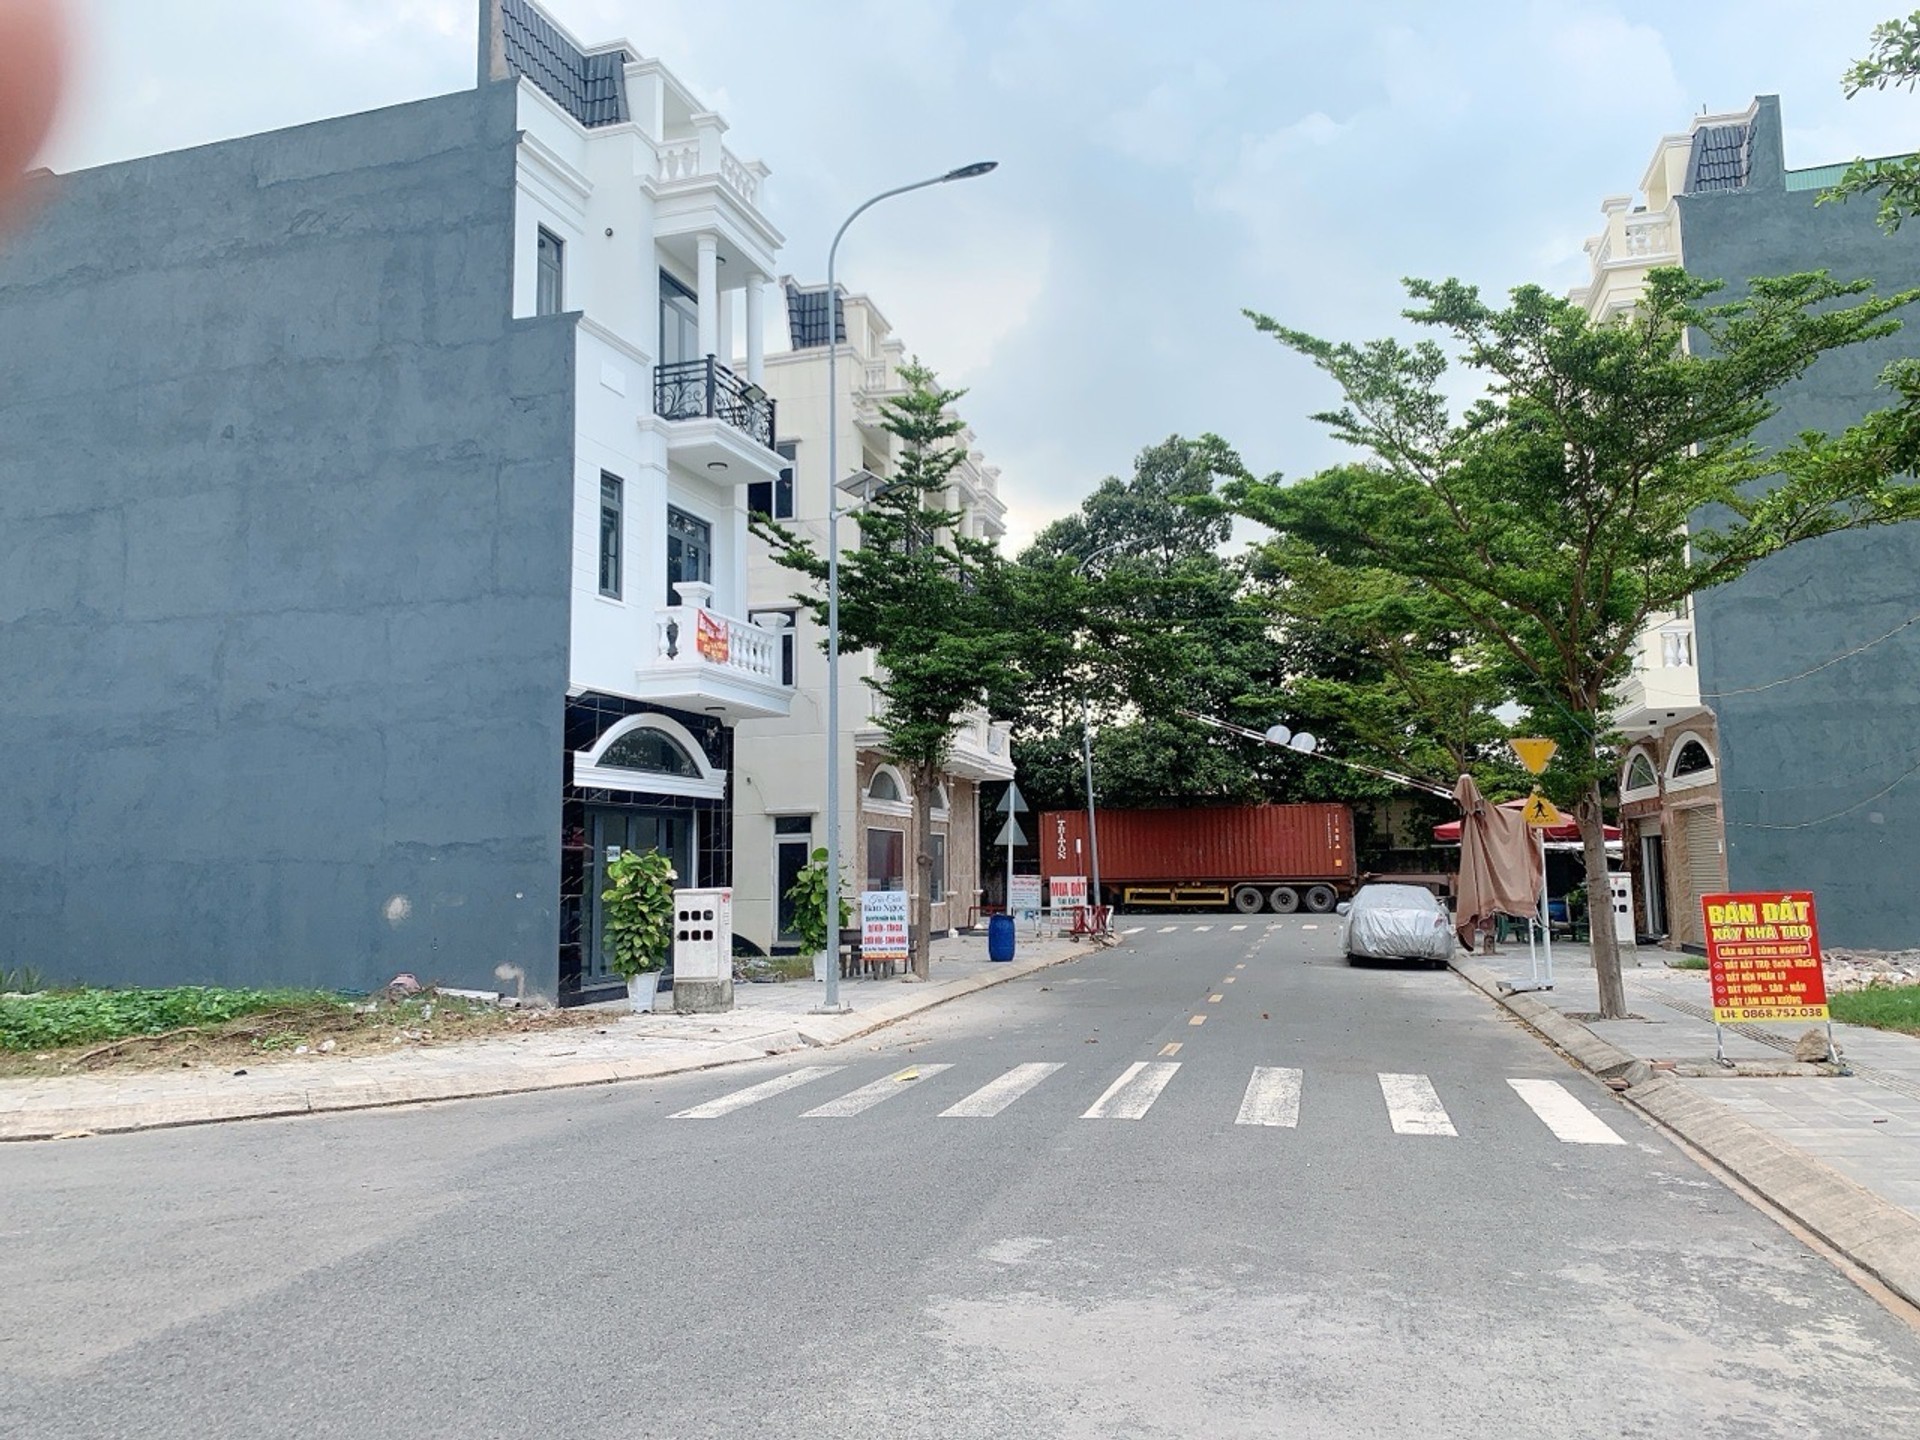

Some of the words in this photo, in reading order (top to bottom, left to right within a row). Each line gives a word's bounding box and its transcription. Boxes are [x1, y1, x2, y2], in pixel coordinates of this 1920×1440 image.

[1051, 882, 1069, 897] MUA
[1762, 896, 1809, 924] ĐẤT
[1712, 926, 1742, 943] XÂY
[1744, 924, 1778, 941] NHÀ
[1779, 925, 1812, 941] TRỌ
[1742, 1008, 1823, 1018] 0868.752.038
